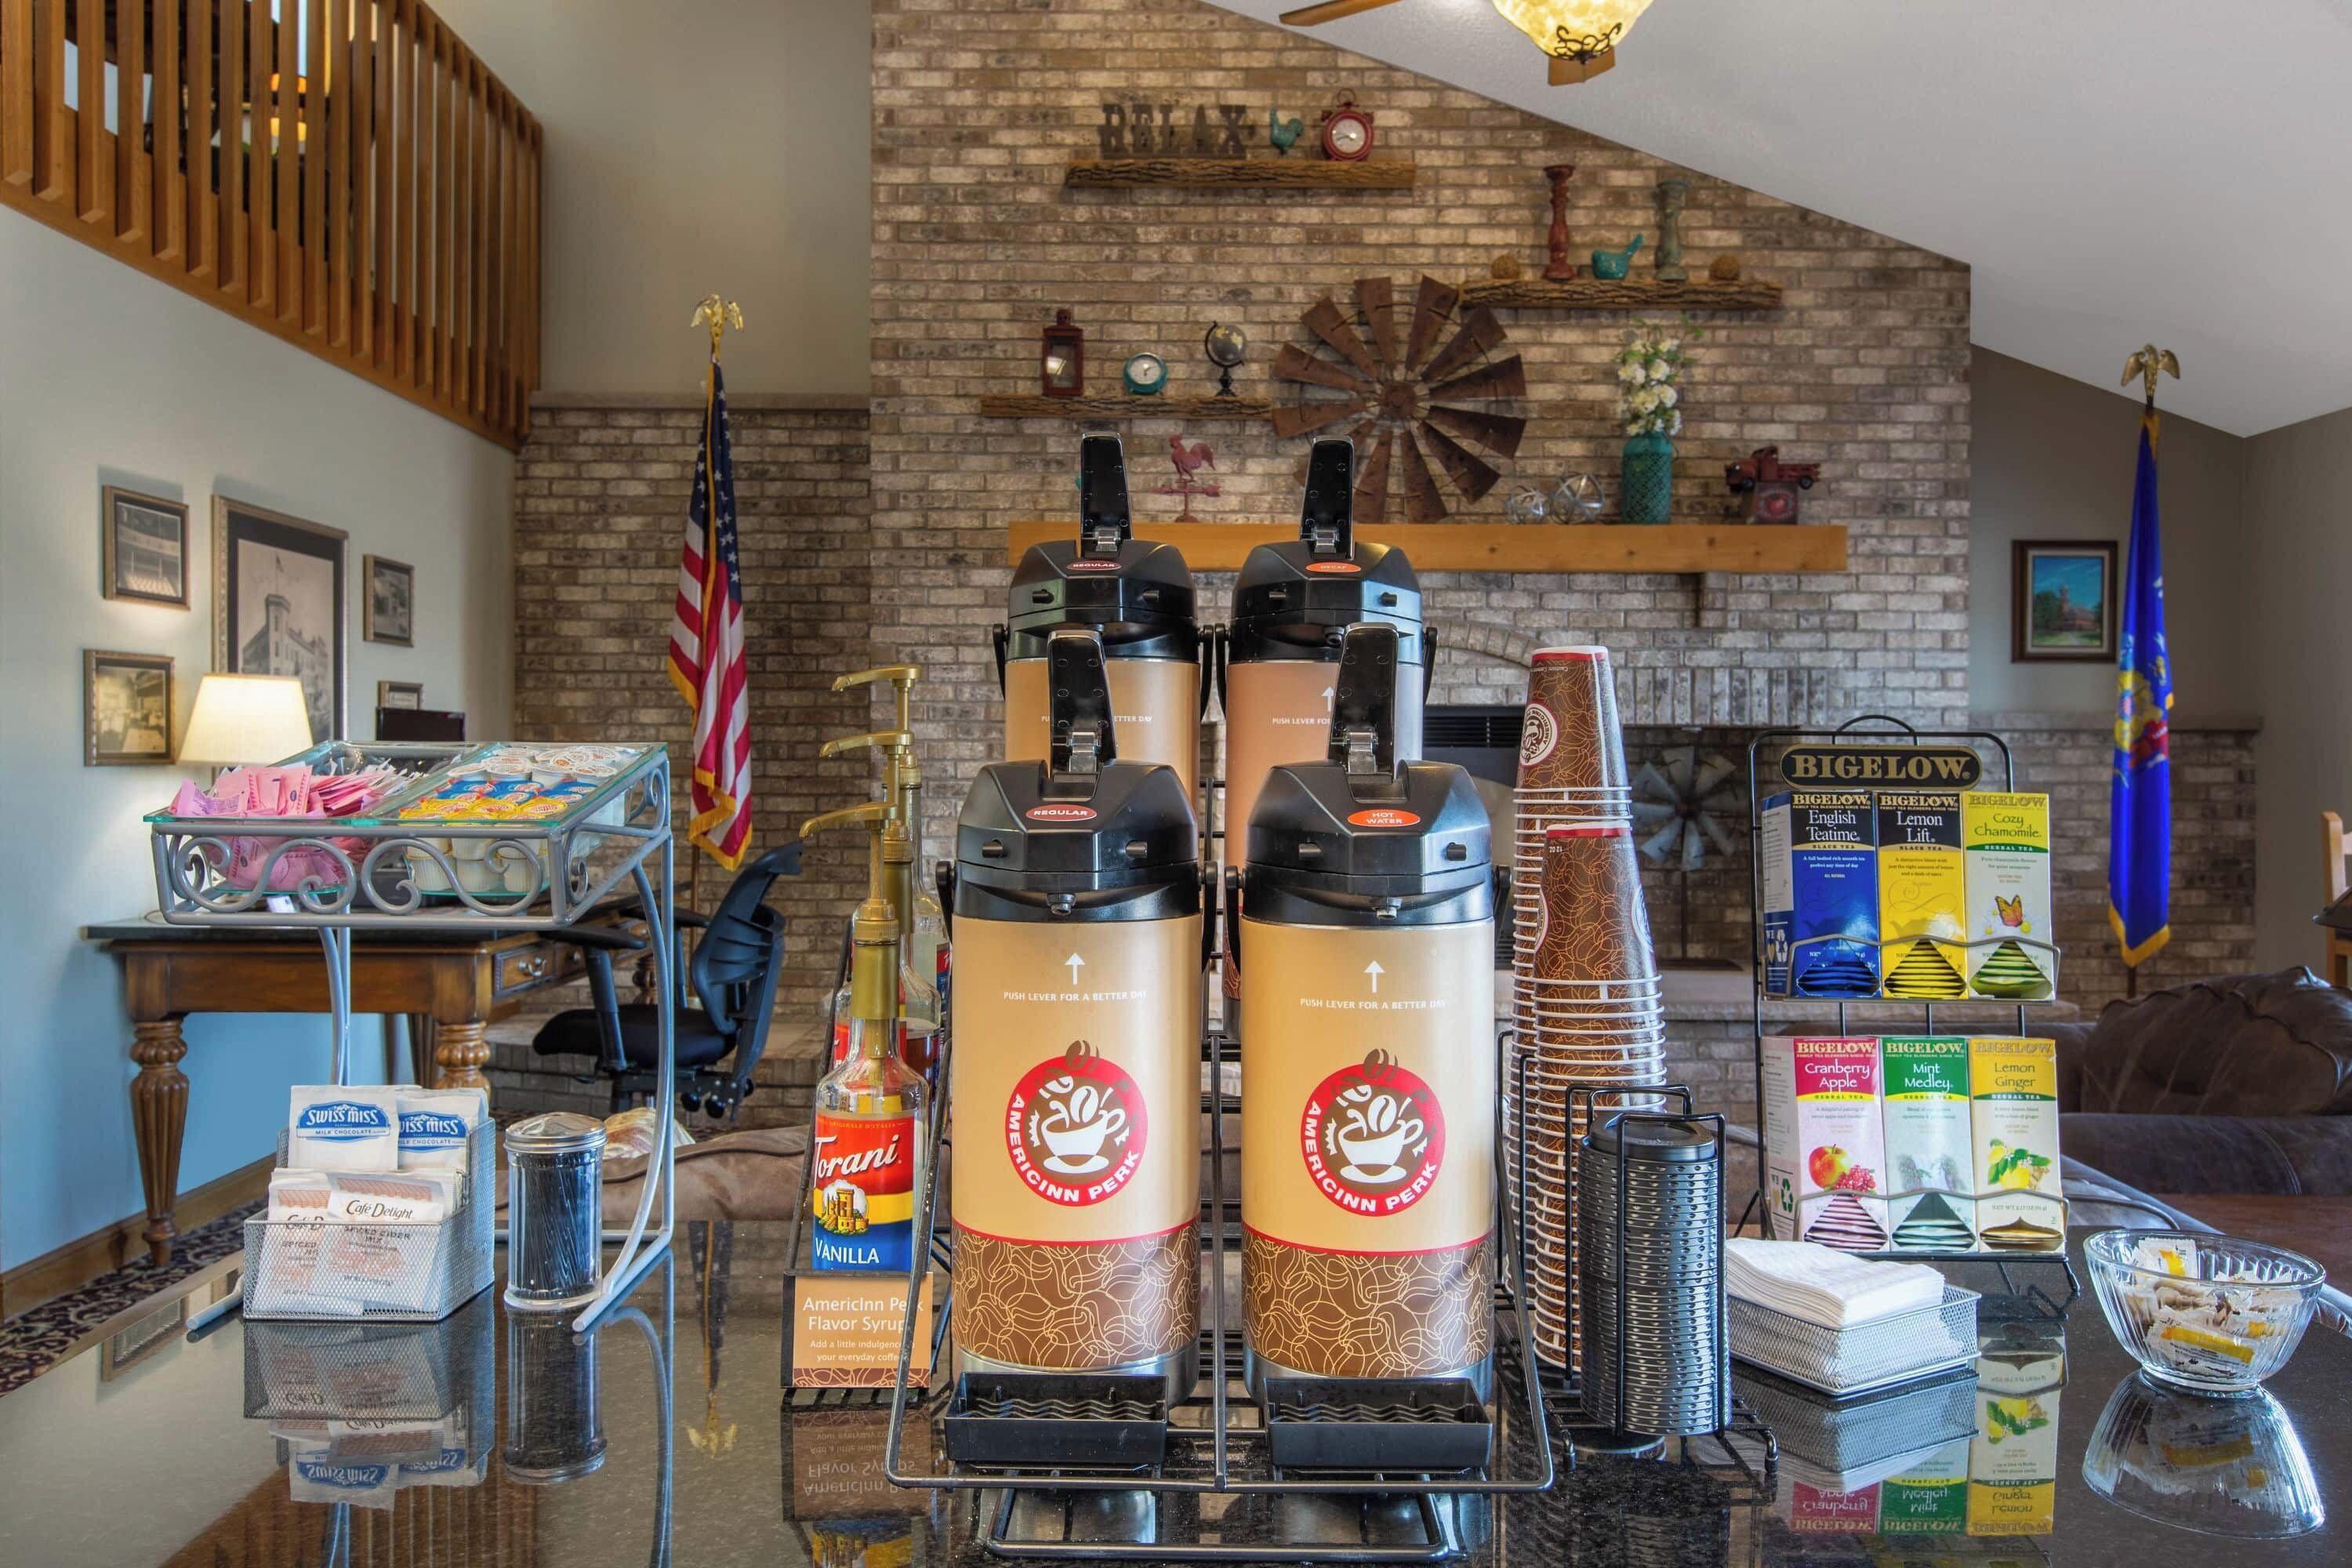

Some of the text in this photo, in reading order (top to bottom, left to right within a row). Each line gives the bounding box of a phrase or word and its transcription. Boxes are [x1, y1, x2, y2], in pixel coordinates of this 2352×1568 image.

[1102, 103, 1247, 155] RELAX
[1791, 754, 1970, 779] BIGELOW
[1793, 794, 1869, 805] BIGELOW
[1879, 795, 1958, 807] BIGELOW
[1968, 795, 2045, 808] BIGELOW
[1034, 808, 1088, 817] REGULAR
[1809, 810, 1857, 827] English
[1896, 811, 1944, 826] Lemon
[1993, 813, 2024, 828] Cozy
[1806, 826, 1857, 841] Teatime
[1907, 828, 1932, 842] Lift
[1974, 822, 2039, 837] Chamomile
[1004, 992, 1025, 1000] PUSH
[1029, 993, 1057, 1001] LEVER
[1093, 992, 1127, 1001] BETTER
[1300, 998, 1323, 1007] PUSH
[1326, 1000, 1355, 1009] LEVER
[1392, 1000, 1425, 1009] BETTER
[1796, 1043, 1874, 1054] BIGELOW
[1886, 1043, 1962, 1054] BIGELOW
[1805, 1058, 1870, 1079] Cranberry
[1913, 1062, 1940, 1073] Mint
[1994, 1062, 2035, 1073] Lemon
[1819, 1075, 1857, 1093] Apple
[1904, 1073, 1950, 1092] Medley
[1994, 1076, 2036, 1092] Ginger
[306, 1109, 379, 1126] SWISS MISS
[426, 1119, 459, 1134] MISS
[1008, 1093, 1140, 1203] AMERICINN PERK
[814, 1134, 899, 1188] Torani
[1305, 1100, 1437, 1212] AMERICINN PERK
[346, 1200, 413, 1221] Café Delight
[815, 1237, 880, 1264] VANILLA
[803, 1298, 924, 1312] AmericInn Pek
[808, 1316, 858, 1330] Flavor
[811, 1340, 827, 1348] Add
[837, 1340, 856, 1348] little
[858, 1341, 902, 1351] indulgenc
[838, 1354, 876, 1363] everyday
